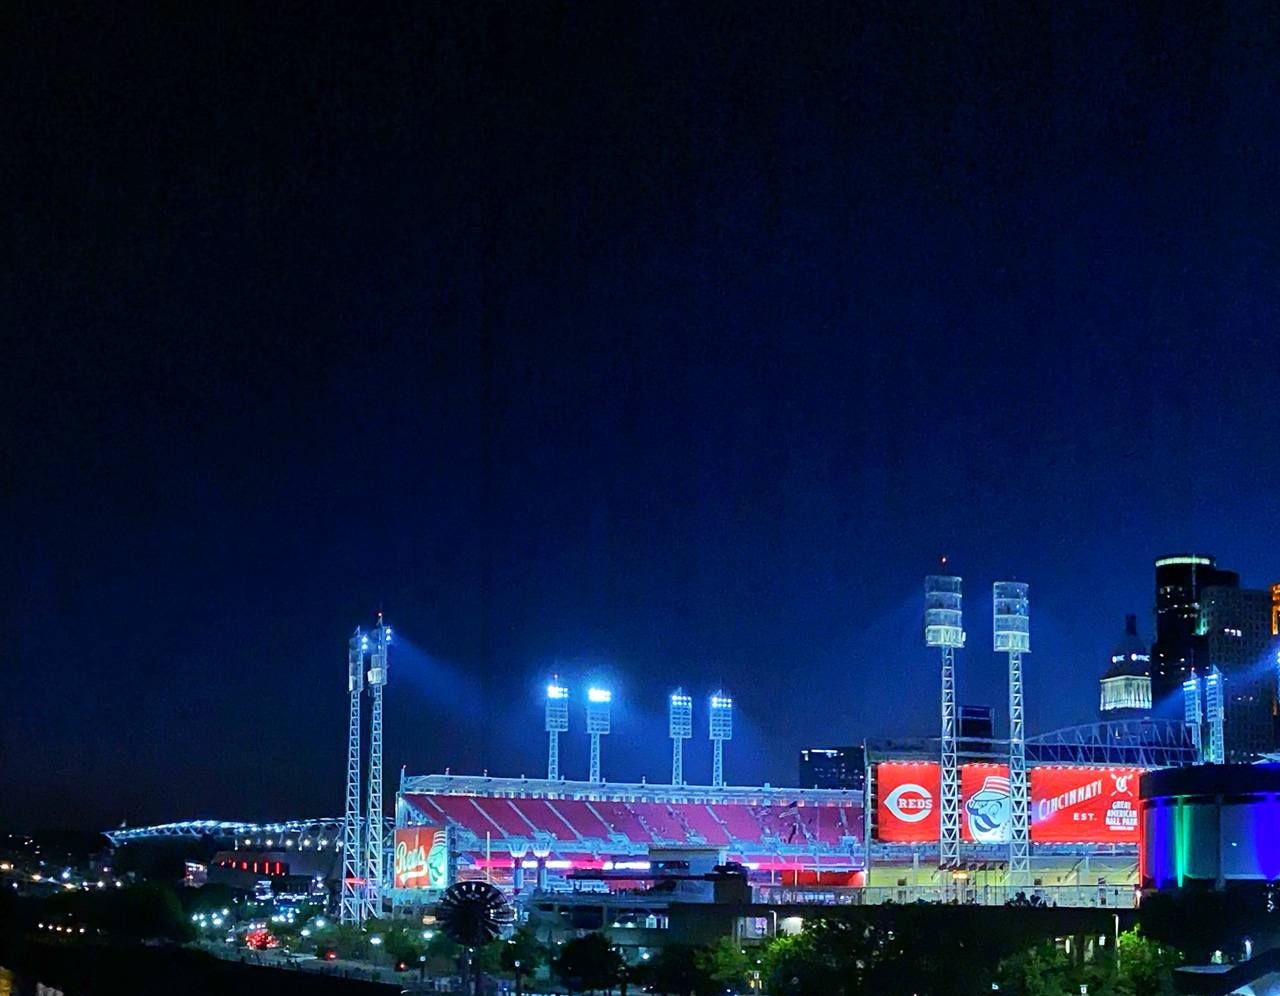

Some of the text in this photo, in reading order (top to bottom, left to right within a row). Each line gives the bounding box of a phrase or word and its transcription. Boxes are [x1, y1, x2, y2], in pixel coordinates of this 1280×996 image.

[898, 799, 933, 809] REDS
[1038, 779, 1102, 821] CINCINNATI
[1112, 801, 1131, 809] GREAT
[1073, 812, 1097, 821] EST.
[1107, 809, 1137, 817] AMERICAN
[1105, 817, 1138, 825] BALL PARK
